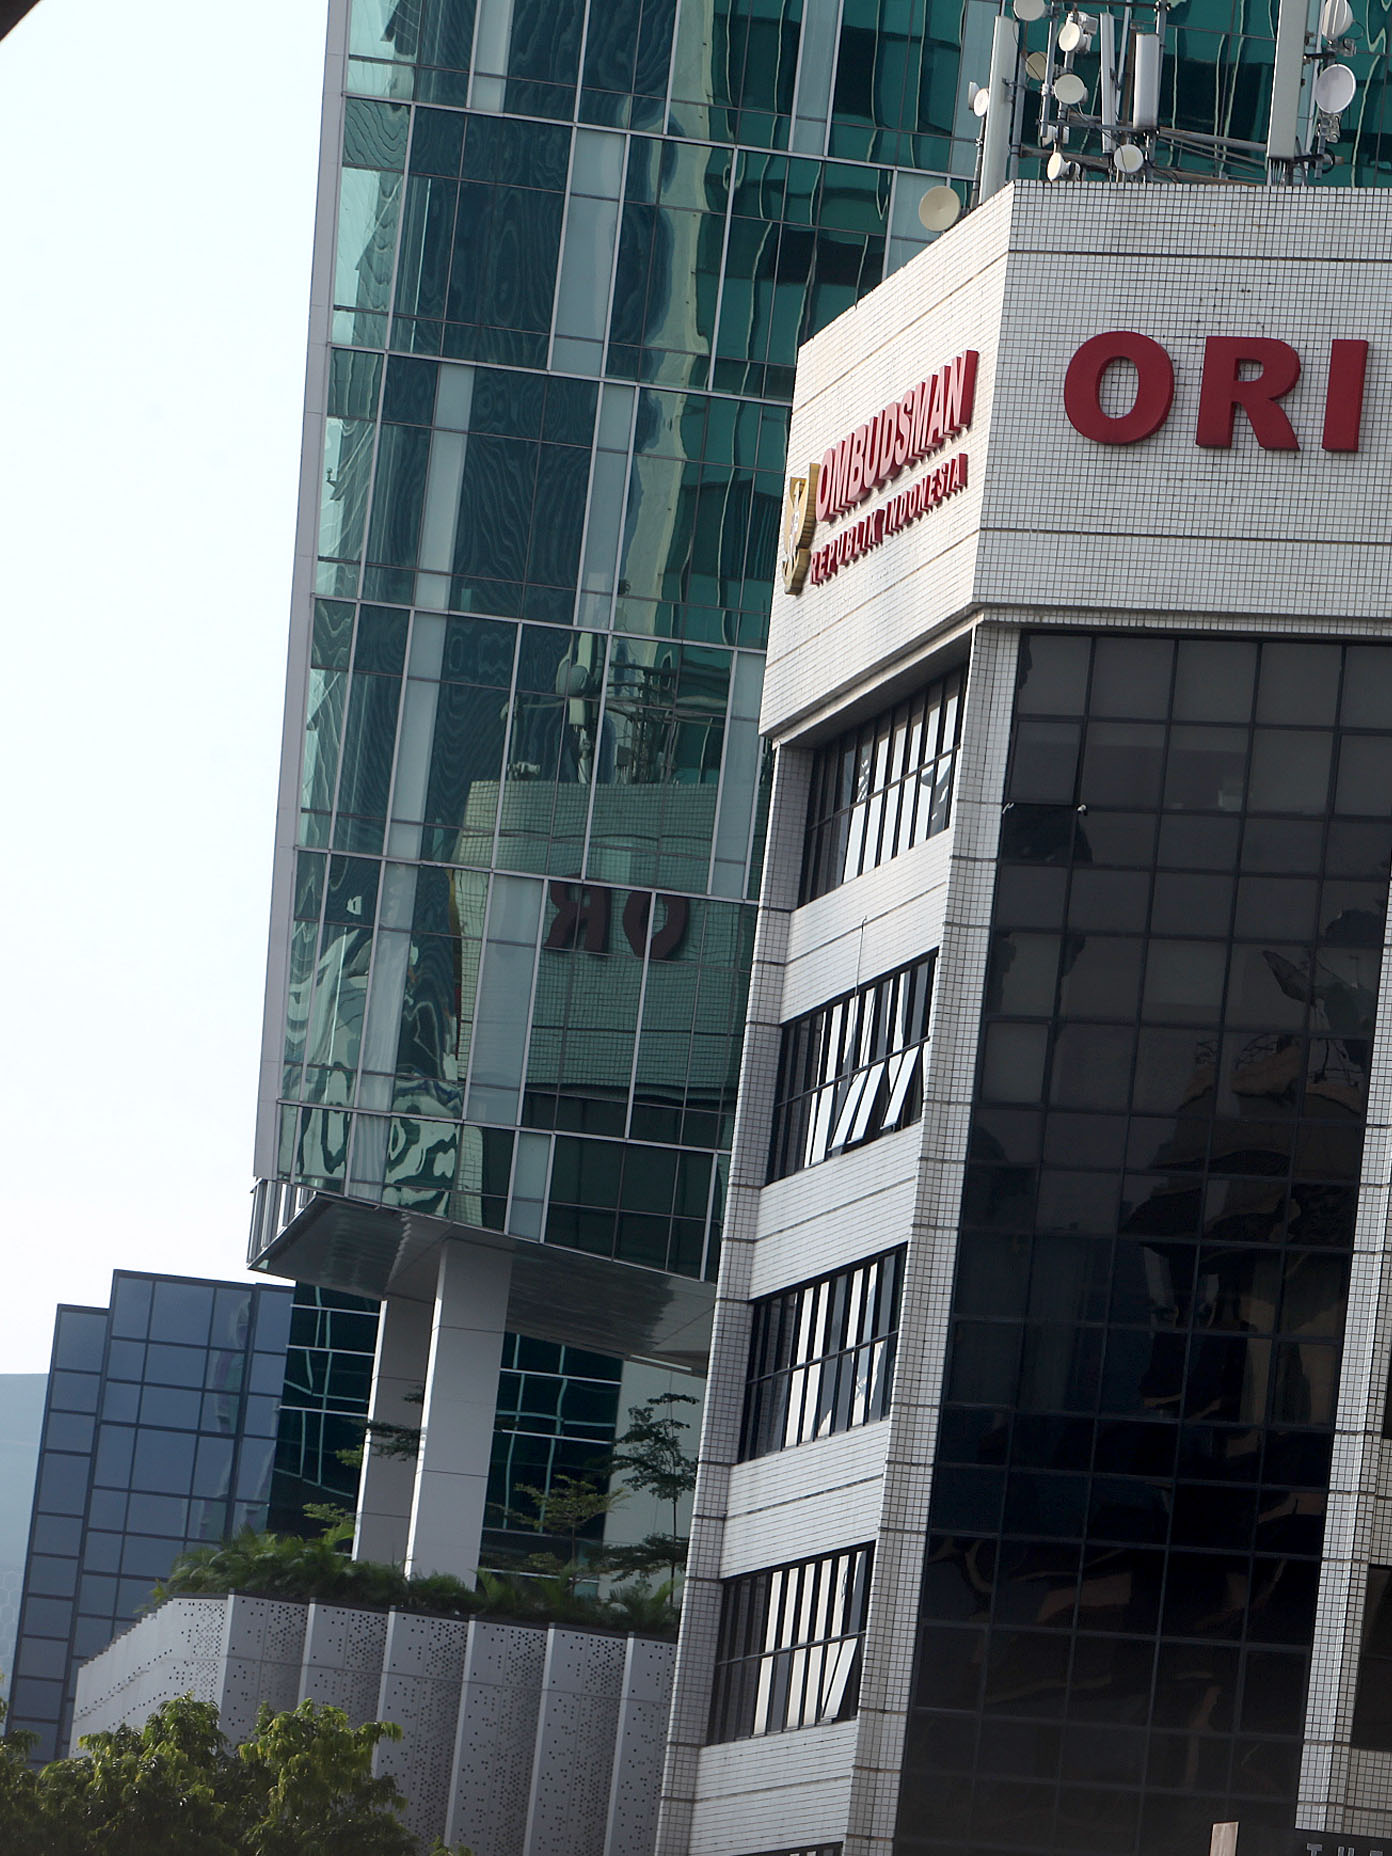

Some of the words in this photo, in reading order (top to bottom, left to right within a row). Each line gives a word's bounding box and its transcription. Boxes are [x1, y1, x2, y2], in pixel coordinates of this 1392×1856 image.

[816, 350, 979, 522] OMBUDSMAN
[1064, 330, 1369, 452] ORI
[811, 509, 885, 586] REPUBLIK
[884, 453, 968, 536] INDONESIA
